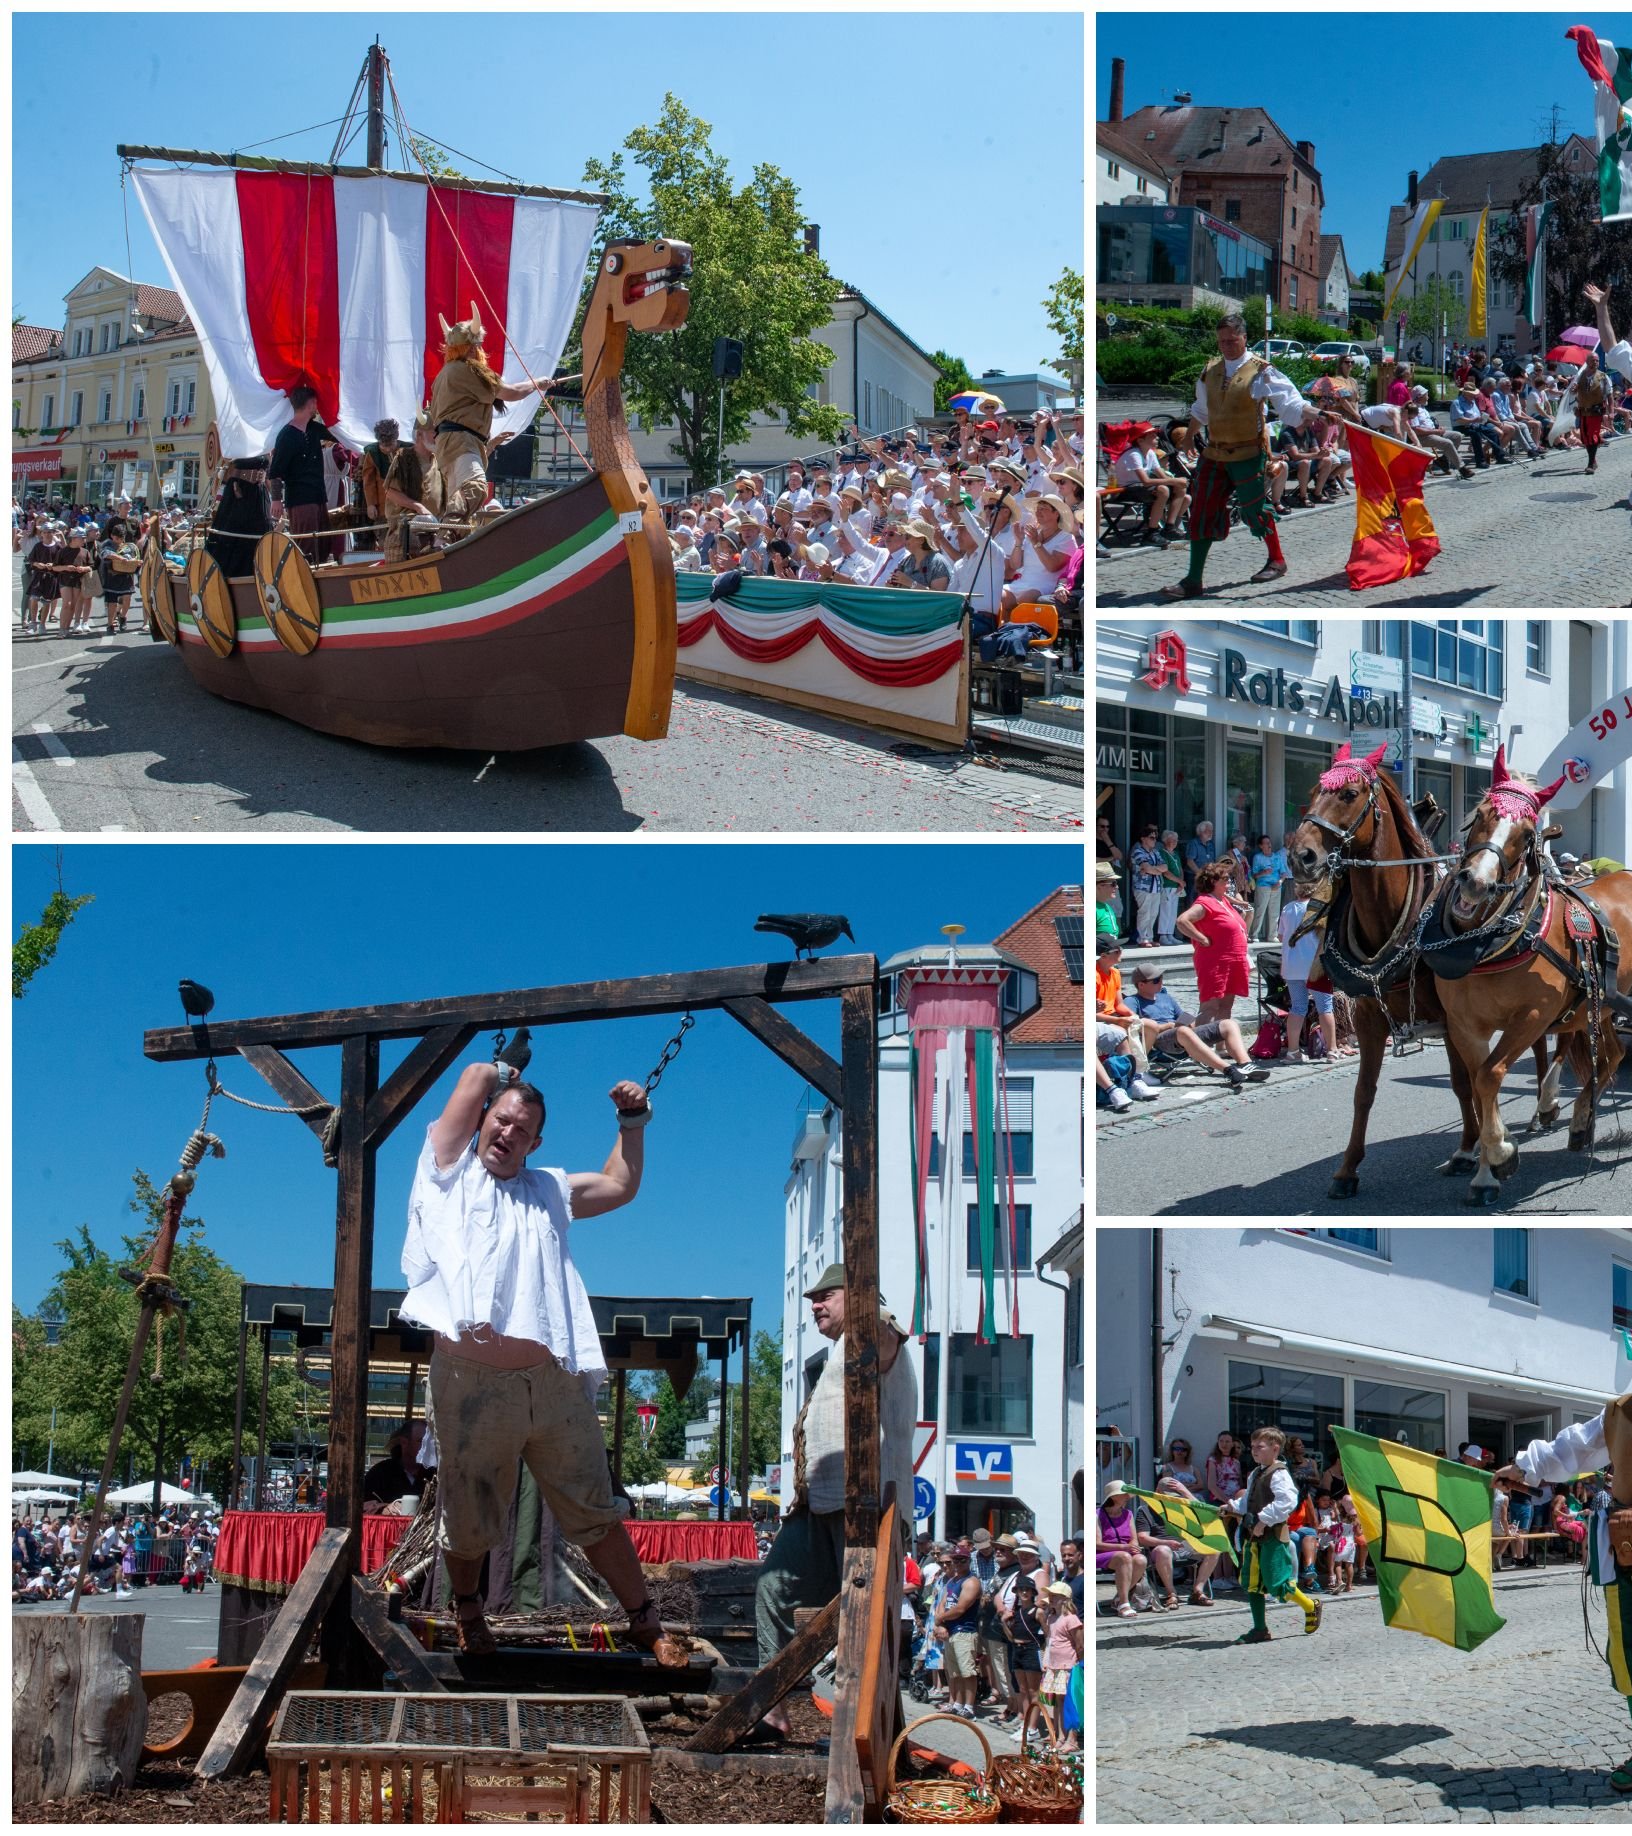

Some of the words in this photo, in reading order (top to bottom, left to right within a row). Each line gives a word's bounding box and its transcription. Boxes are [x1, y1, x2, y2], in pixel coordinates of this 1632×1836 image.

[12, 456, 61, 473] ungsverkauf
[628, 520, 638, 532] 82
[1363, 689, 1371, 700] 13
[1588, 708, 1618, 741] 50
[1186, 1365, 1194, 1377] 9
